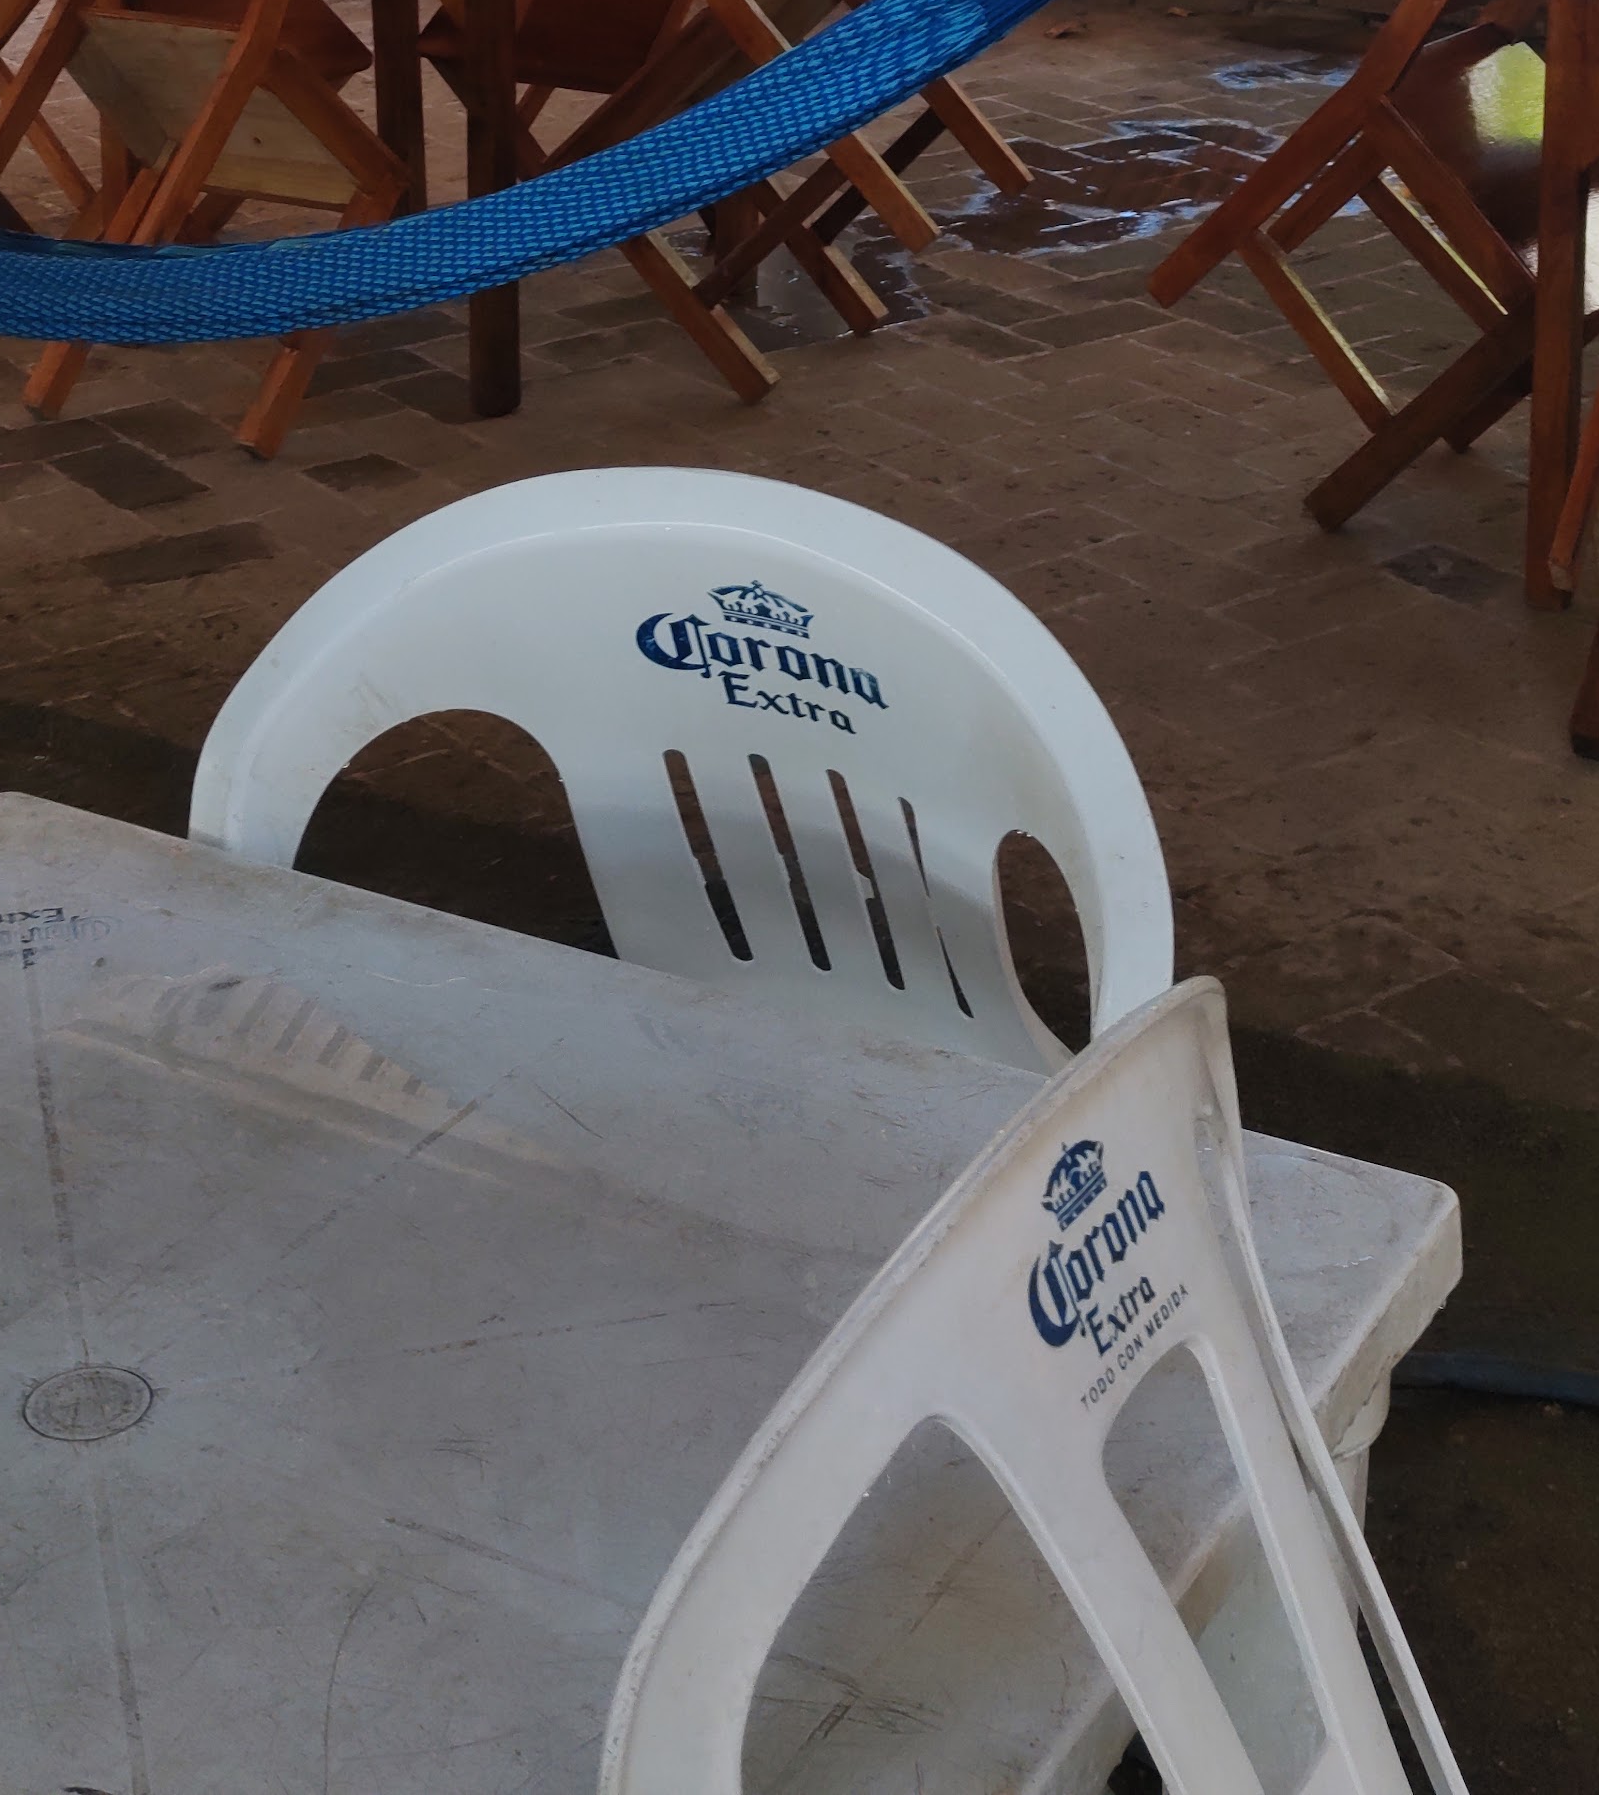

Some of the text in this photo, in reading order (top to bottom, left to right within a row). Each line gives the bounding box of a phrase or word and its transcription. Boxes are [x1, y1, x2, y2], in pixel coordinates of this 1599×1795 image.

[635, 612, 890, 710] Corona
[718, 670, 857, 735] Extra
[1027, 1170, 1166, 1348] Corona
[1080, 1282, 1189, 1411] TODO CON MEDIDA
[1085, 1276, 1156, 1358] Extra
